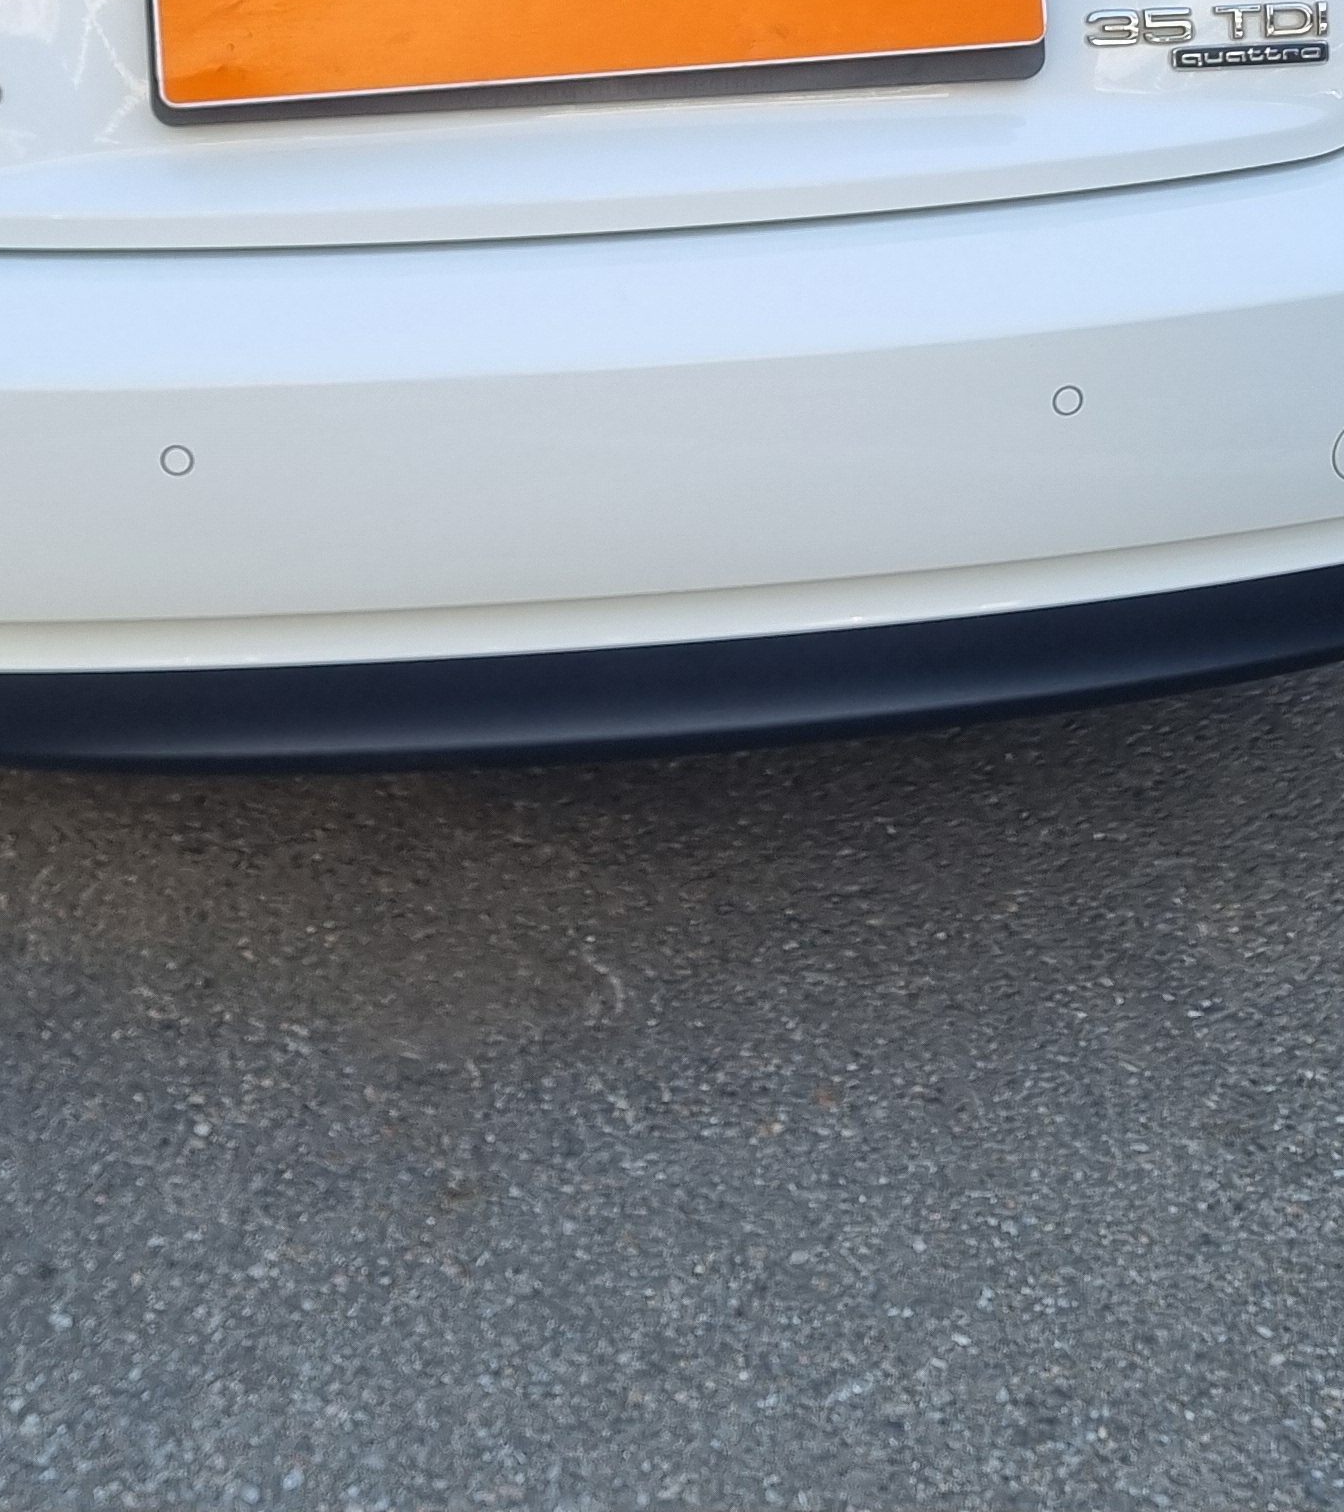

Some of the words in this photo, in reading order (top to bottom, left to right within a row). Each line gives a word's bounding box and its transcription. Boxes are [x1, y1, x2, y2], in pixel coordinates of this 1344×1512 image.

[1085, 6, 1194, 46] 35
[1211, 0, 1329, 39] TDI
[1181, 45, 1321, 68] quattro
